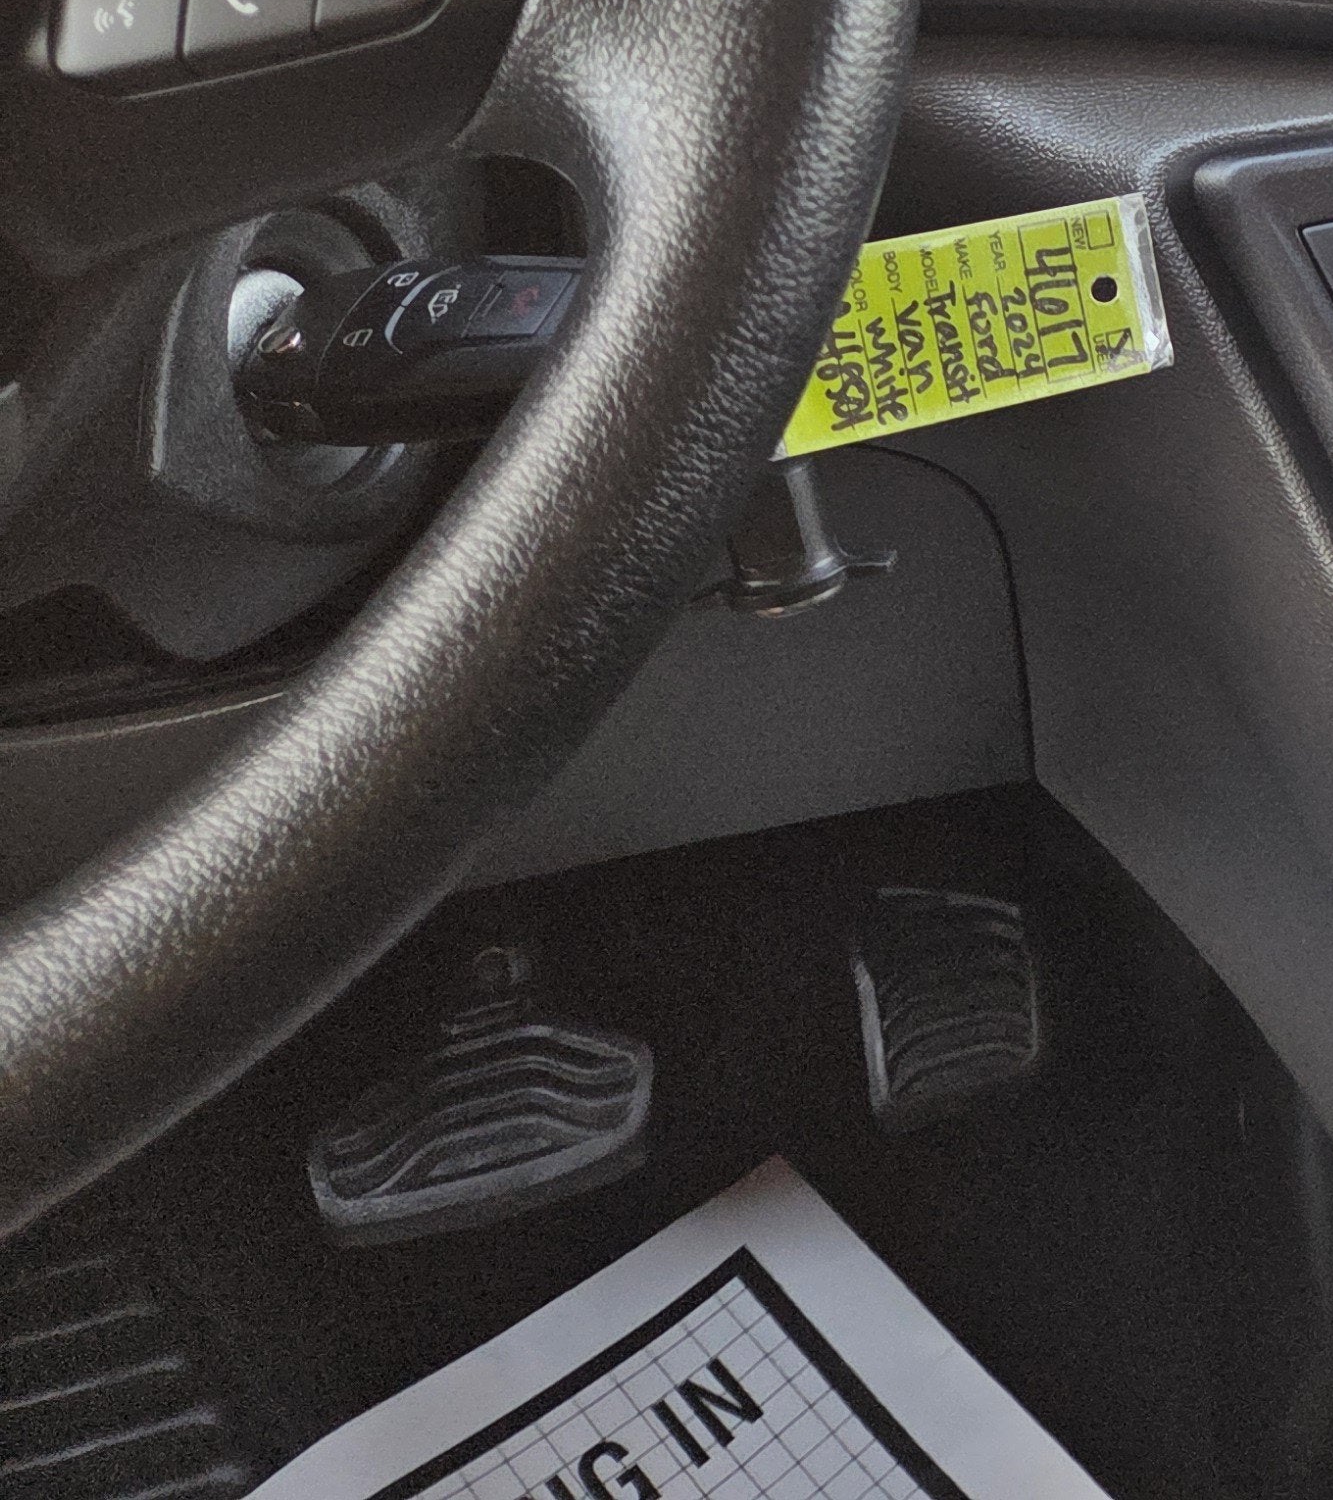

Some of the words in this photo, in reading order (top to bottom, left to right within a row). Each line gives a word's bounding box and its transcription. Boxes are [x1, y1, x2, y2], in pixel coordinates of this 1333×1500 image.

[987, 230, 1008, 272] YEAR
[1071, 217, 1087, 250] NEW
[882, 250, 904, 293] BODY
[955, 237, 974, 280] MAKE
[927, 280, 981, 405] Transit
[1000, 286, 1045, 381] 2024
[650, 1357, 764, 1468] IN
